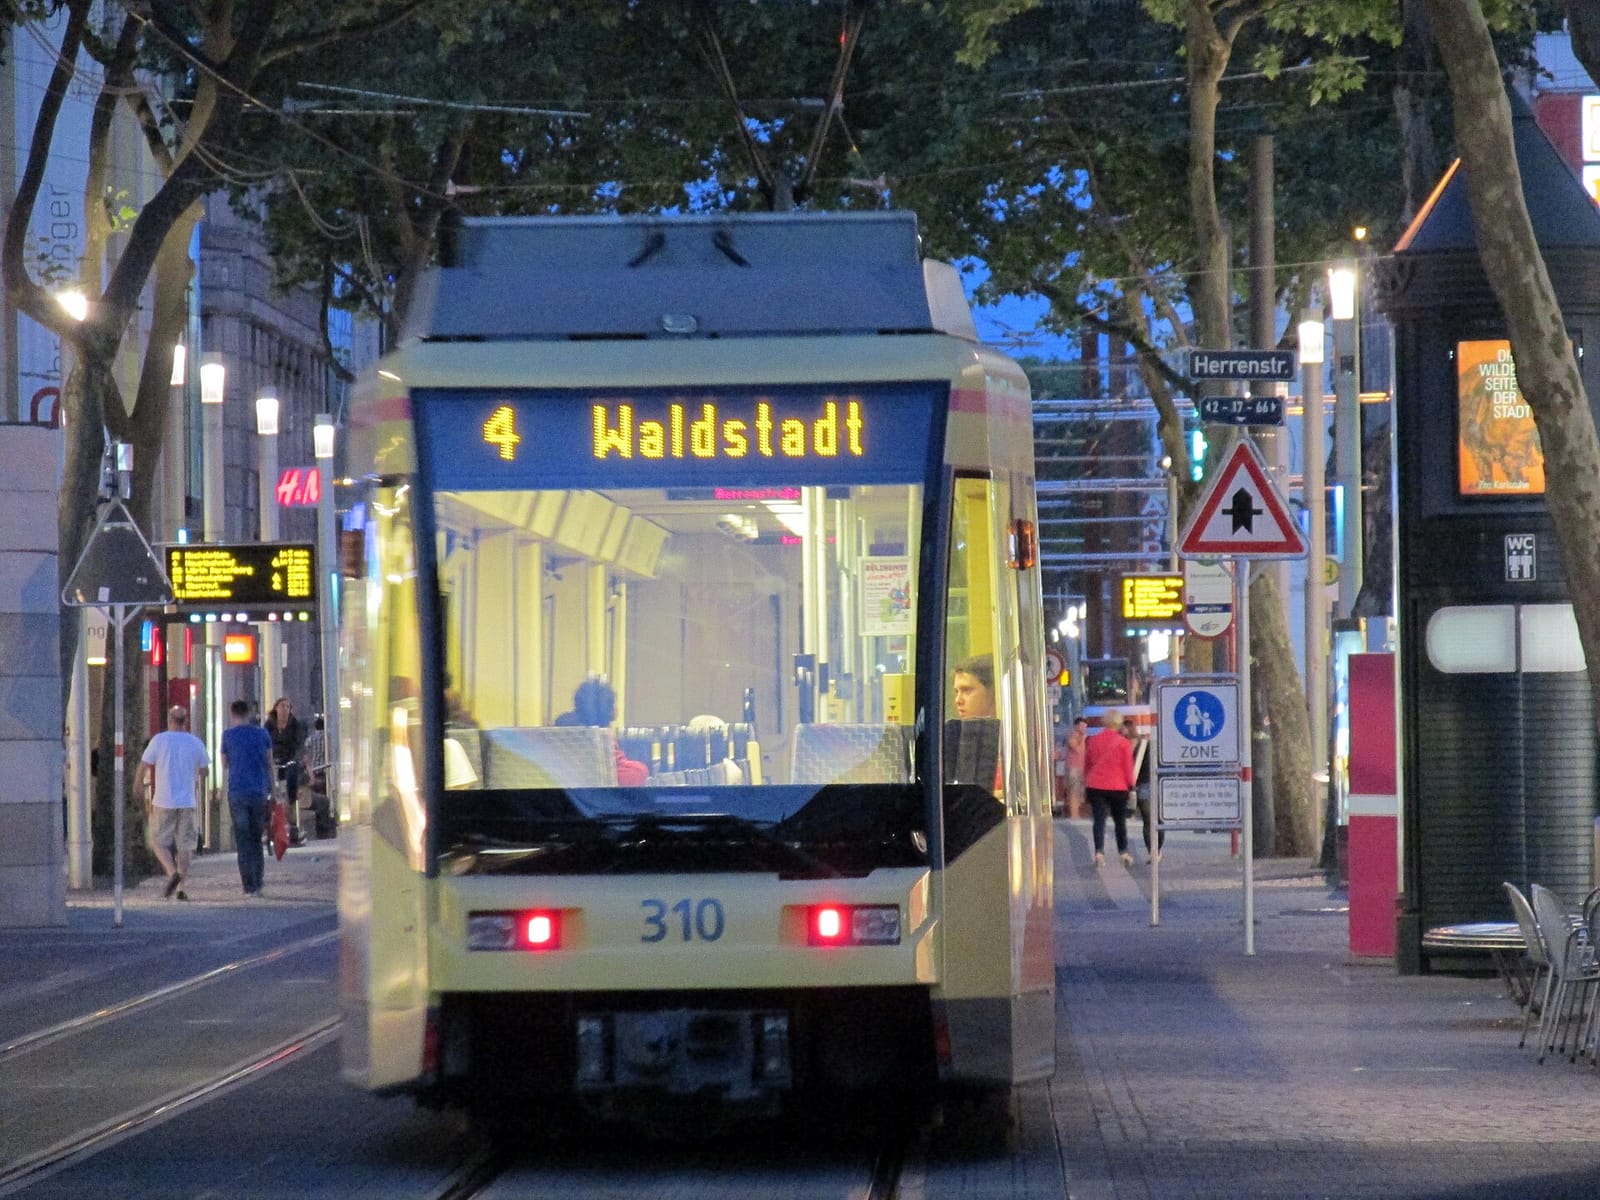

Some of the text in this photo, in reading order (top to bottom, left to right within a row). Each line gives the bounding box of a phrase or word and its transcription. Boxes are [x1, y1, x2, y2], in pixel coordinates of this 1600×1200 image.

[1194, 355, 1289, 374] Herrenstr.
[1480, 363, 1516, 377] WILDE
[1485, 378, 1517, 390] SEITE
[1493, 392, 1517, 404] DER
[1493, 405, 1531, 418] STADT
[483, 401, 864, 460] 4 Waldstadt
[1508, 537, 1533, 550] WC
[1180, 745, 1220, 759] ZONE
[640, 897, 725, 944] 310
